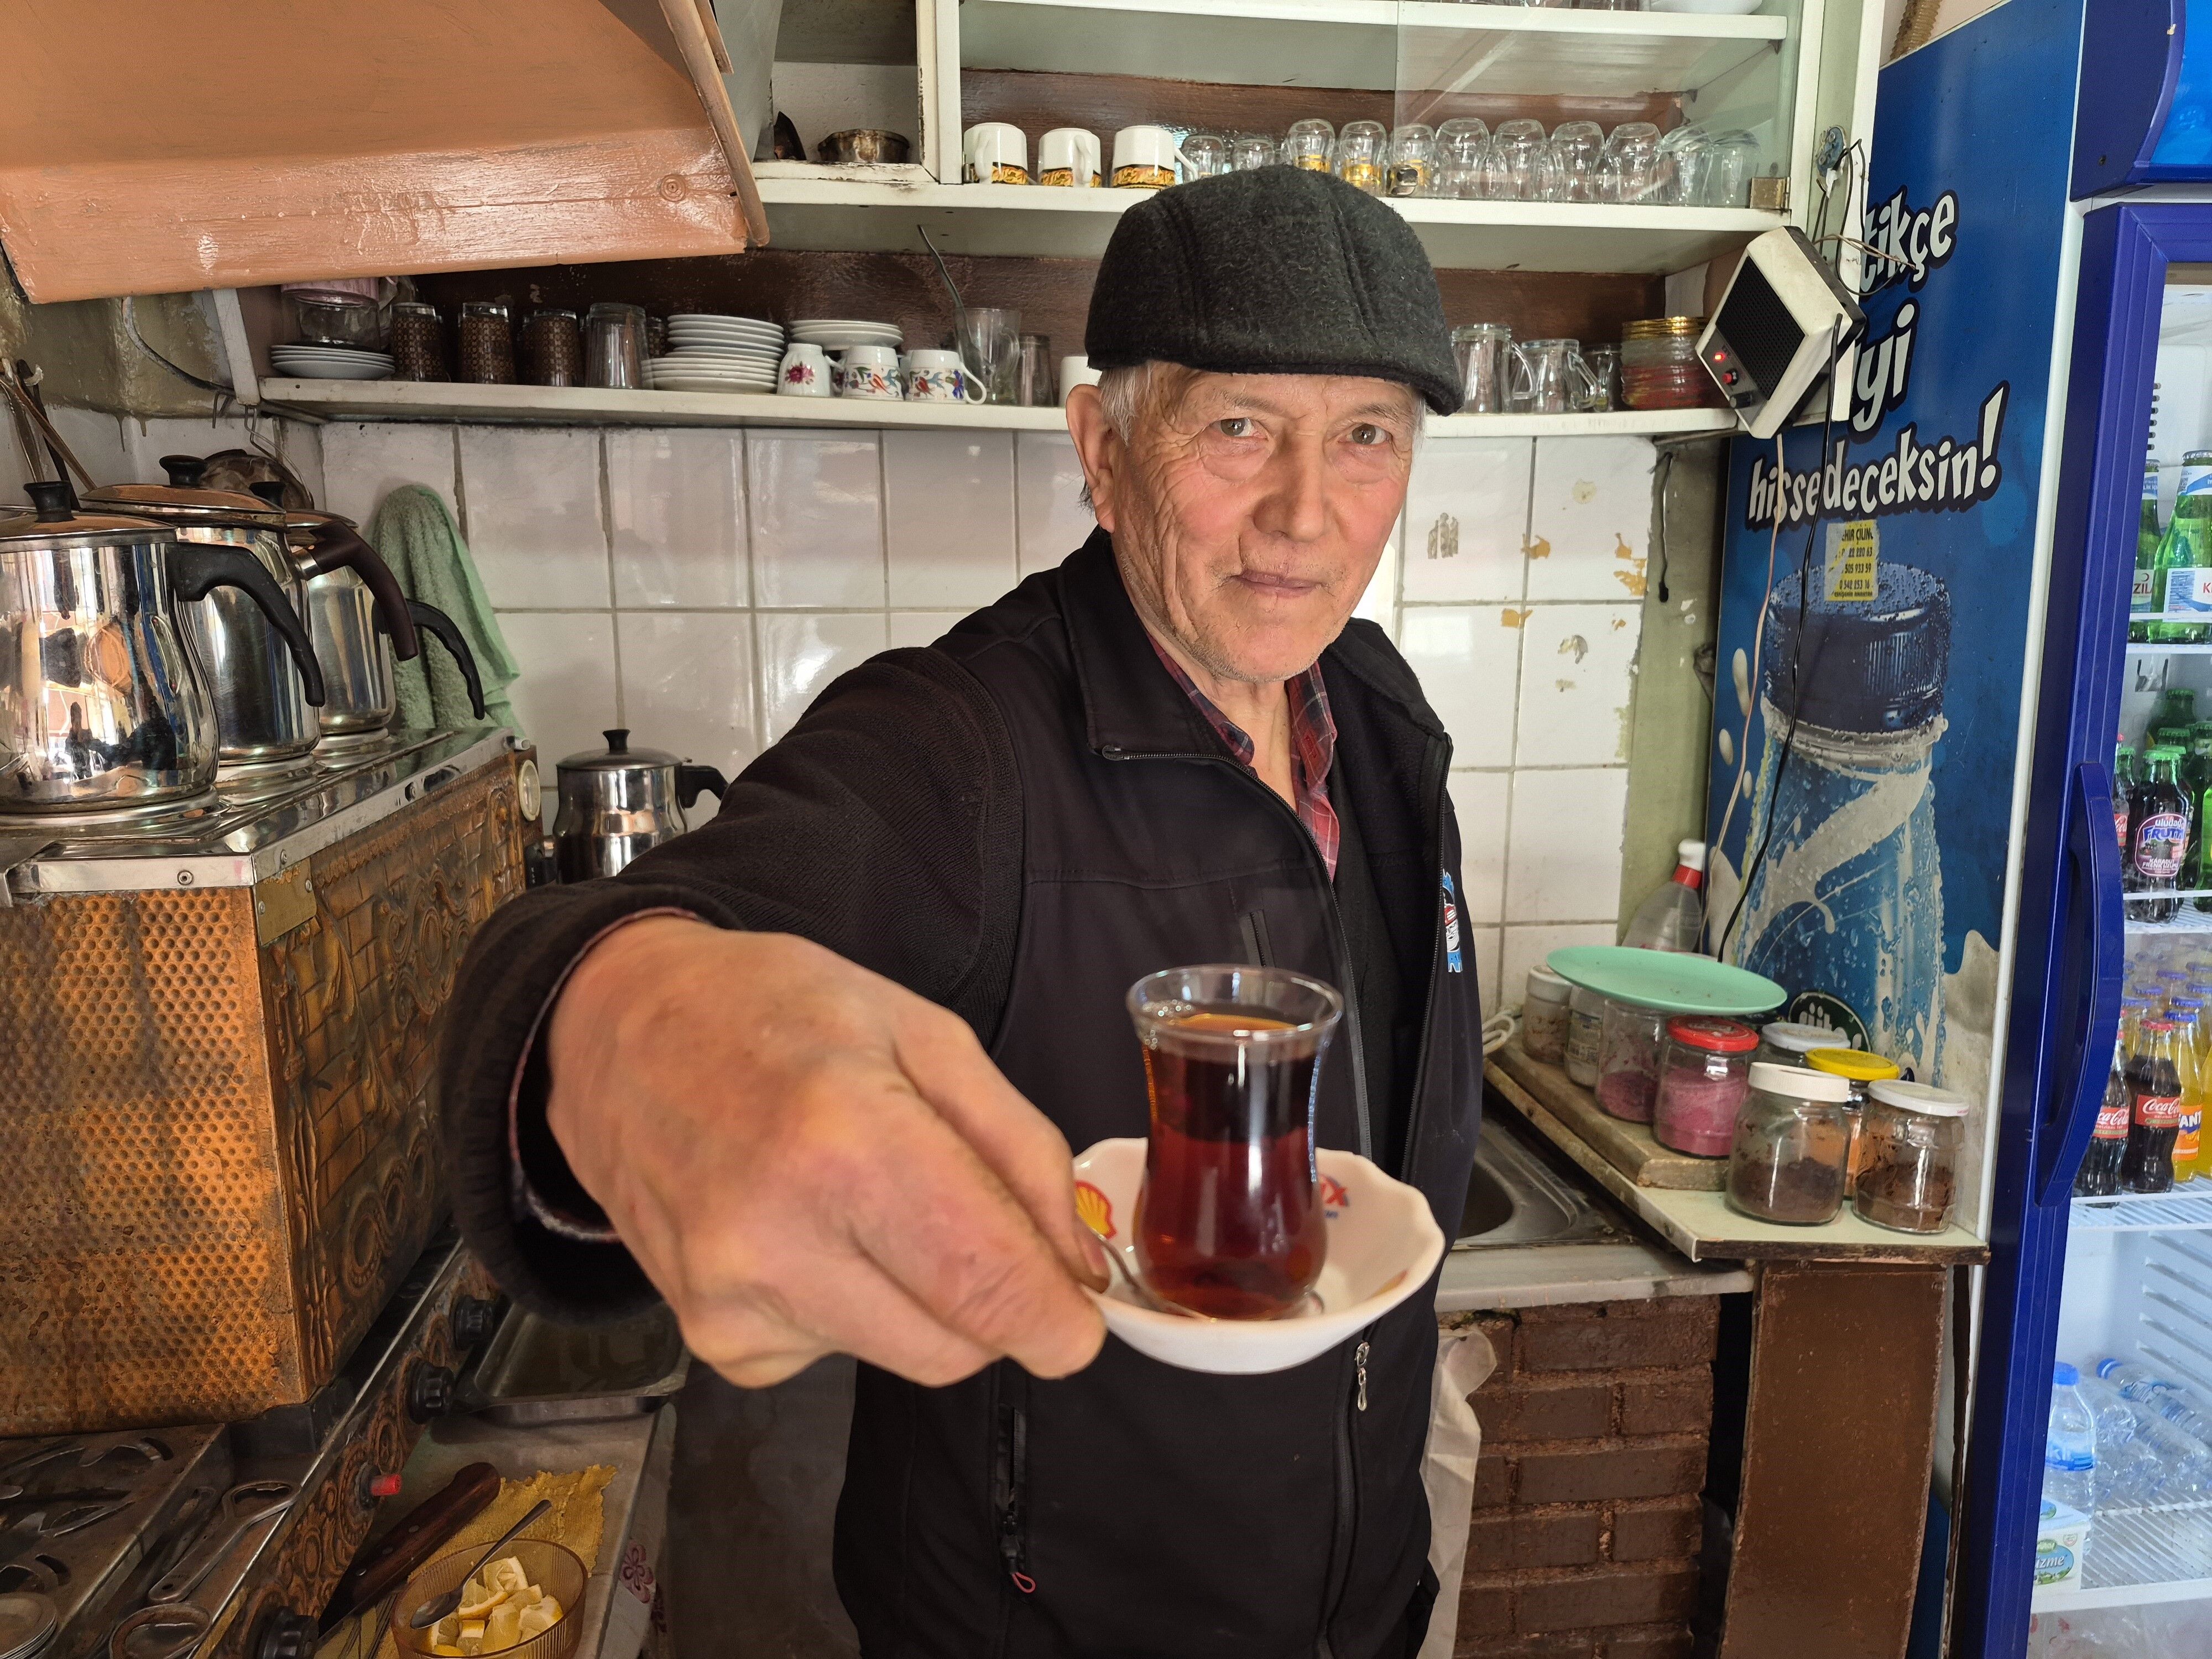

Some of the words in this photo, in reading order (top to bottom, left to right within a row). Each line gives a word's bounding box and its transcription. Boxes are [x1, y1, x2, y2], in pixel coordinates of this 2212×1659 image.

[1860, 192, 1955, 292] tikçe
[1853, 304, 1915, 432] yi
[1748, 387, 2004, 524] hissedeceksin!
